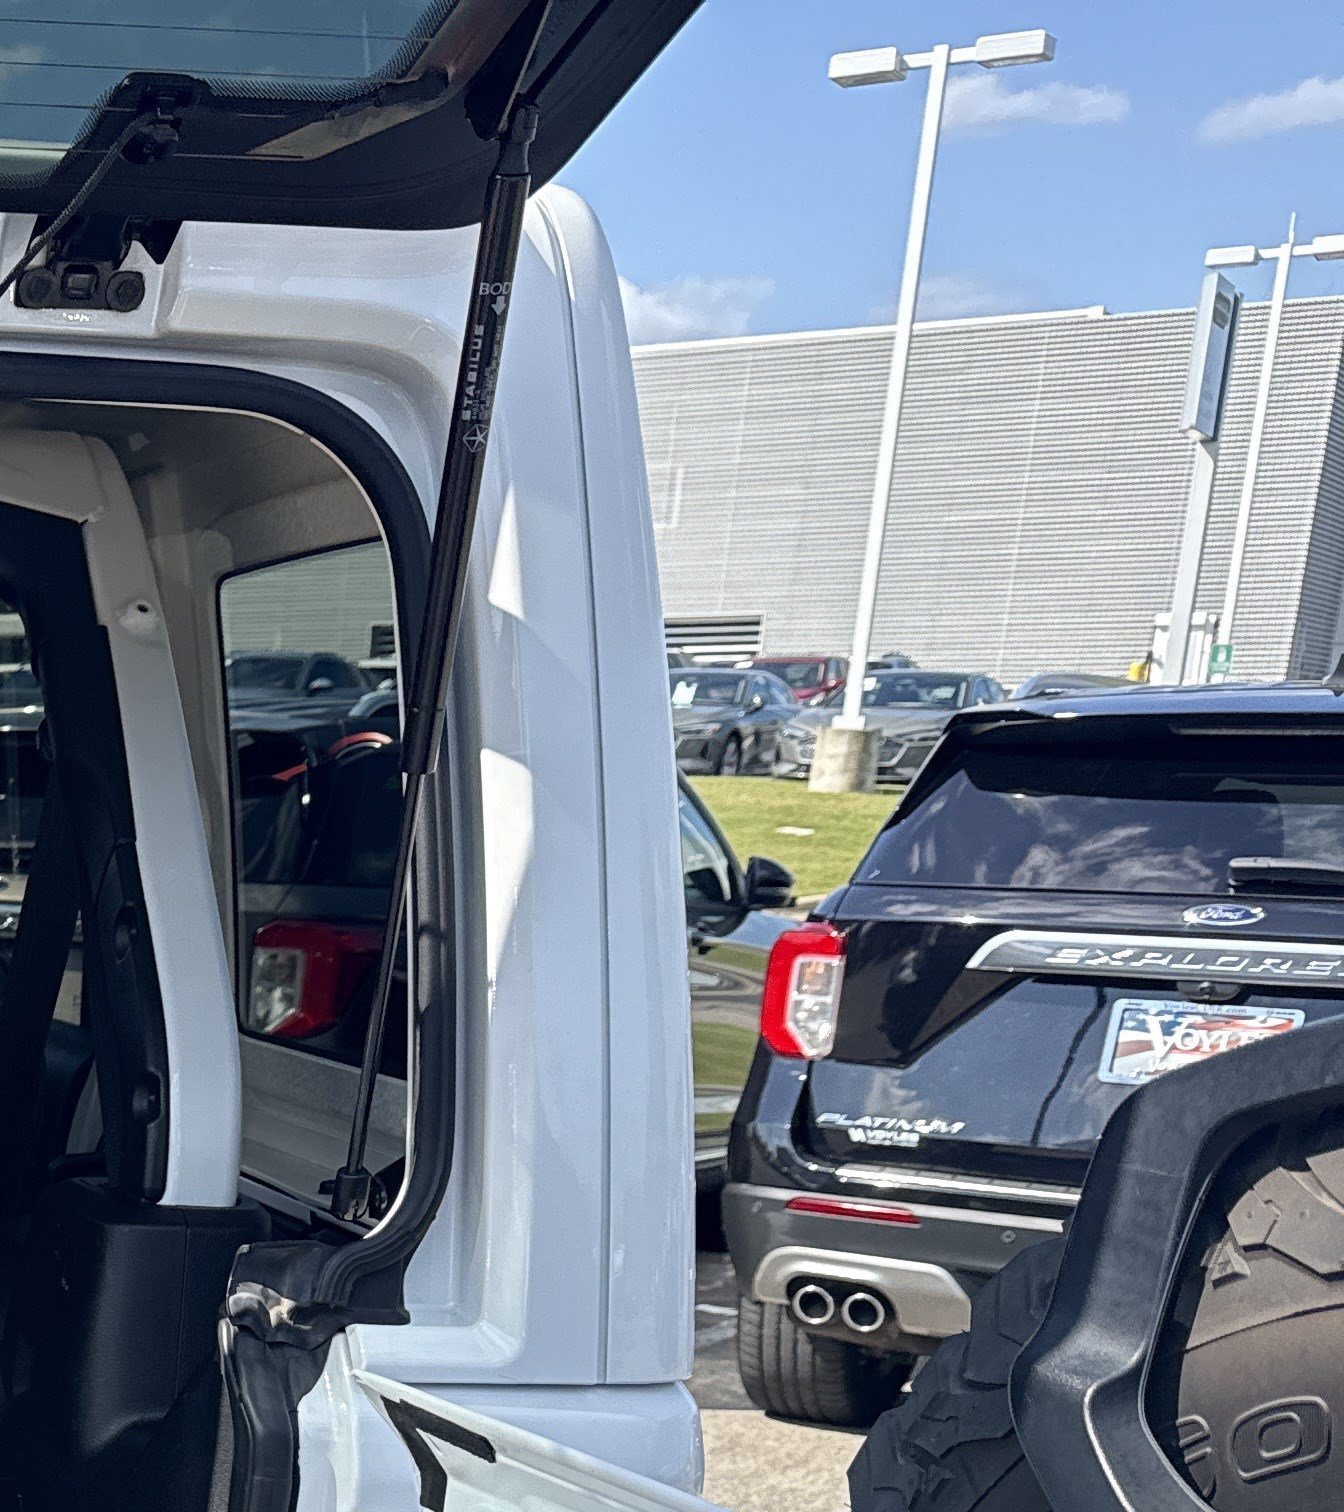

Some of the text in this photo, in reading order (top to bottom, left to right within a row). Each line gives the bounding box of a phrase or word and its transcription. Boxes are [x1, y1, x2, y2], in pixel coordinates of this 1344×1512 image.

[479, 282, 512, 295] BOD
[461, 323, 486, 421] STABILUS
[1044, 948, 1344, 976] EXPLORE
[816, 1112, 966, 1134] PLATINUM
